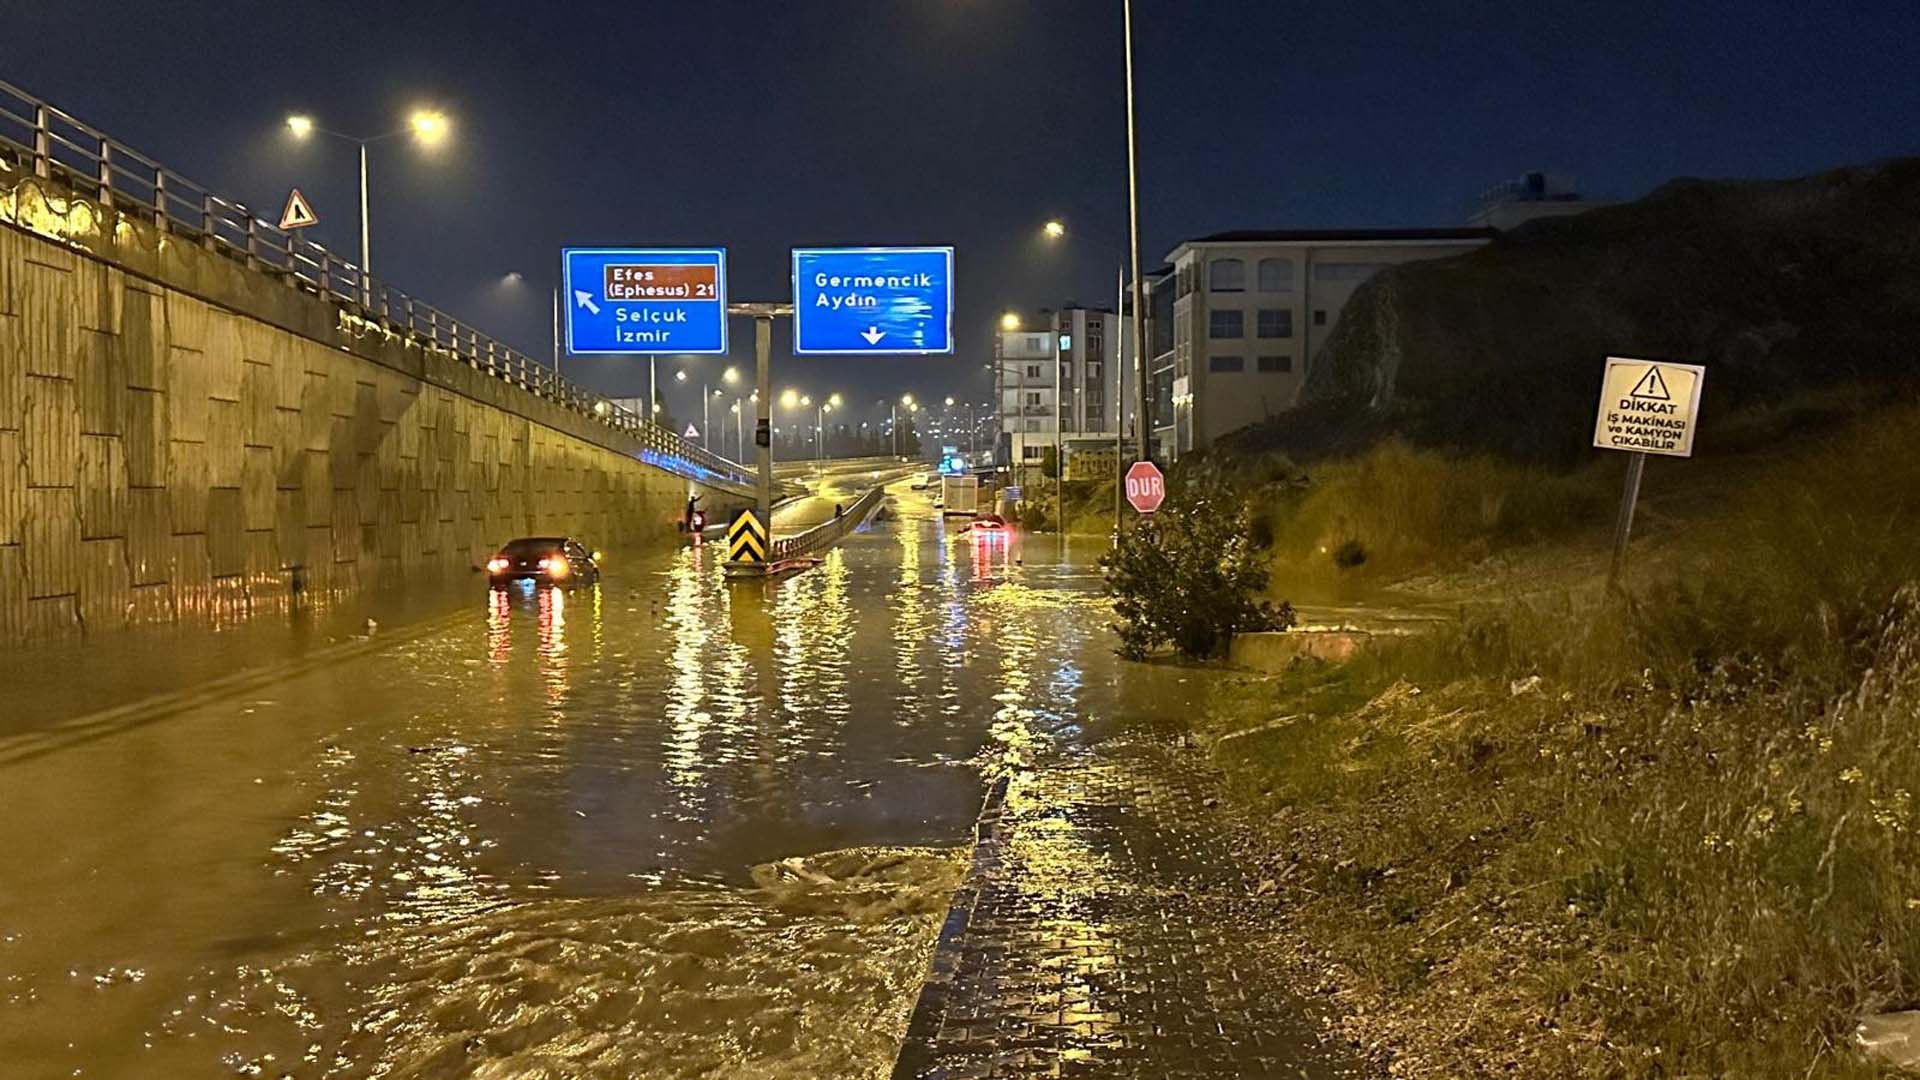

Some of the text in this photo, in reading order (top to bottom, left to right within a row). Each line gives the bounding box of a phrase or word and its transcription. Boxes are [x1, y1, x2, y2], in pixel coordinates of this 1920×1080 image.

[613, 268, 654, 281] Efes
[815, 272, 931, 287] Germencik
[608, 283, 715, 299] (Ephesus) 21
[815, 292, 877, 310] Aydın
[615, 308, 687, 323] Selçuk
[615, 325, 671, 342] İzmir
[1619, 397, 1678, 415] DİKKAT
[1607, 410, 1686, 429] İŞ MAKİNASI
[1608, 425, 1682, 440] ve KAMYON
[1129, 477, 1161, 497] DUR
